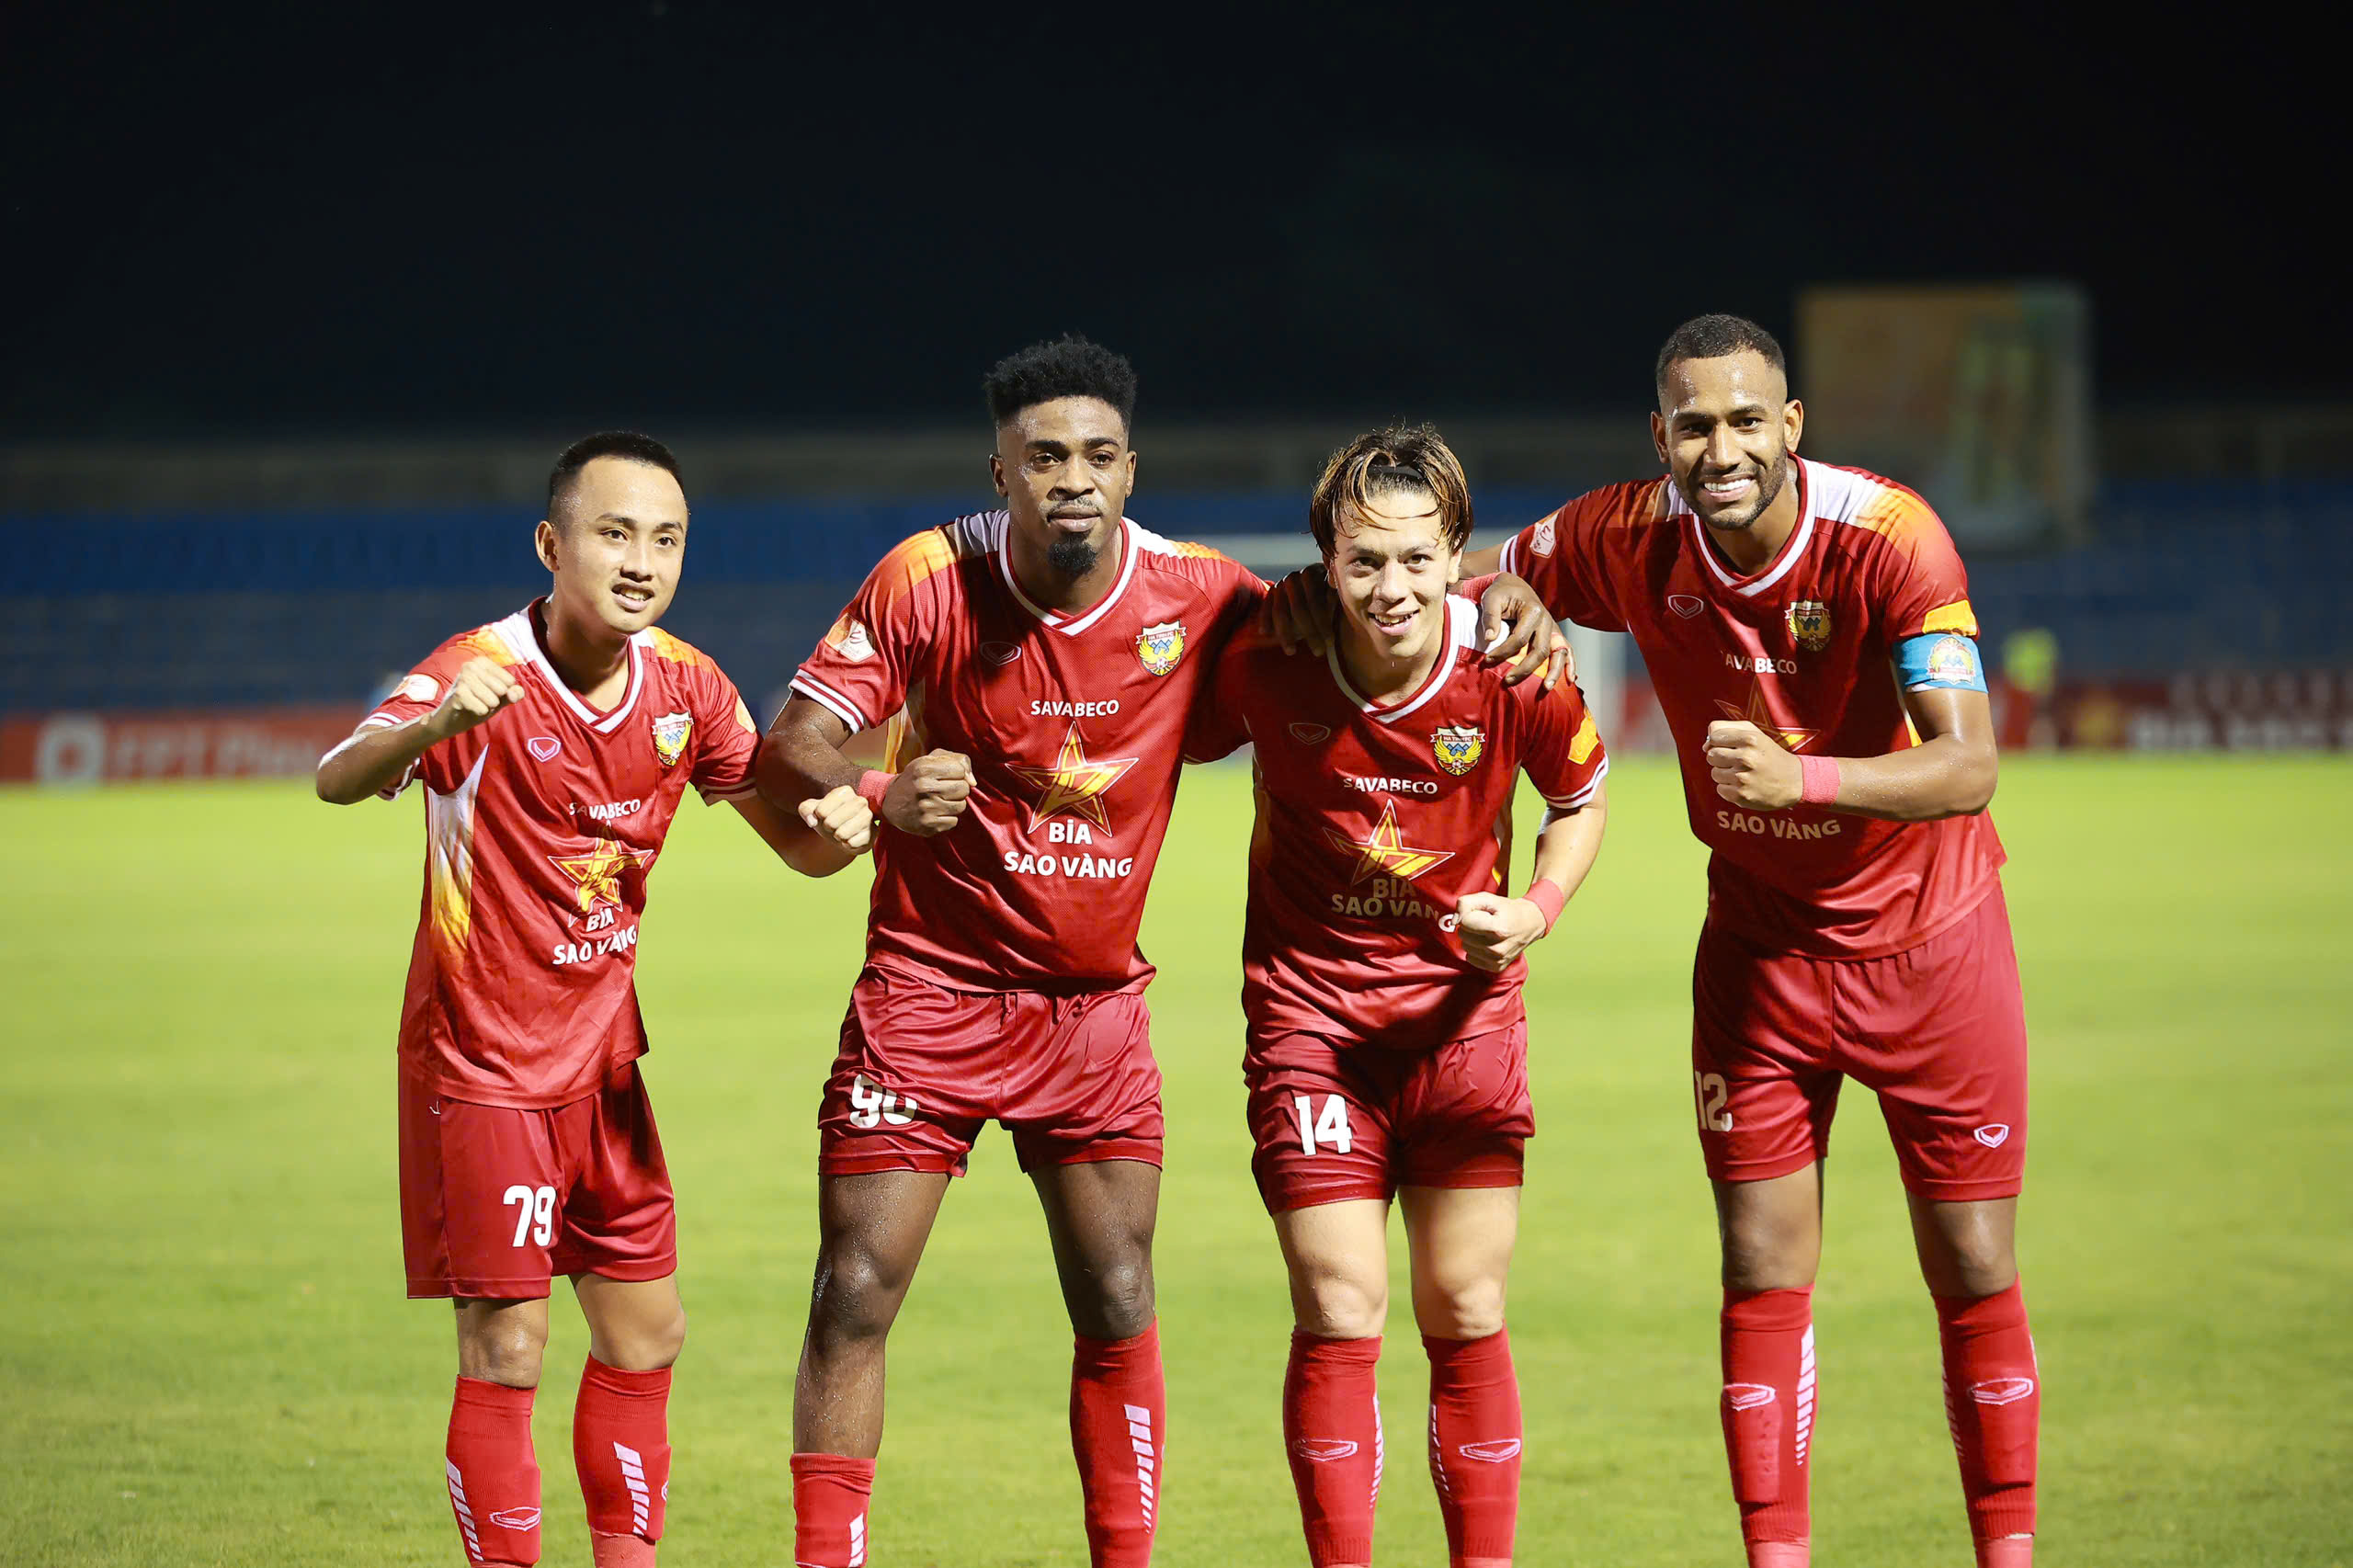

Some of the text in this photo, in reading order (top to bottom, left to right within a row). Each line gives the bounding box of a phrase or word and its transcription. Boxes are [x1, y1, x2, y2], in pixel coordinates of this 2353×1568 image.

[1721, 650, 1797, 674] AVABECO
[1029, 699, 1120, 717] SAVABECO
[1344, 777, 1438, 794] SAVABECO
[1717, 811, 1841, 839] SAO VÀNG
[1004, 851, 1132, 879] SAO VÀNG
[1331, 893, 1383, 916] SAO
[552, 941, 593, 965] SAO
[1294, 1094, 1353, 1156] 14
[503, 1185, 557, 1247] 79
